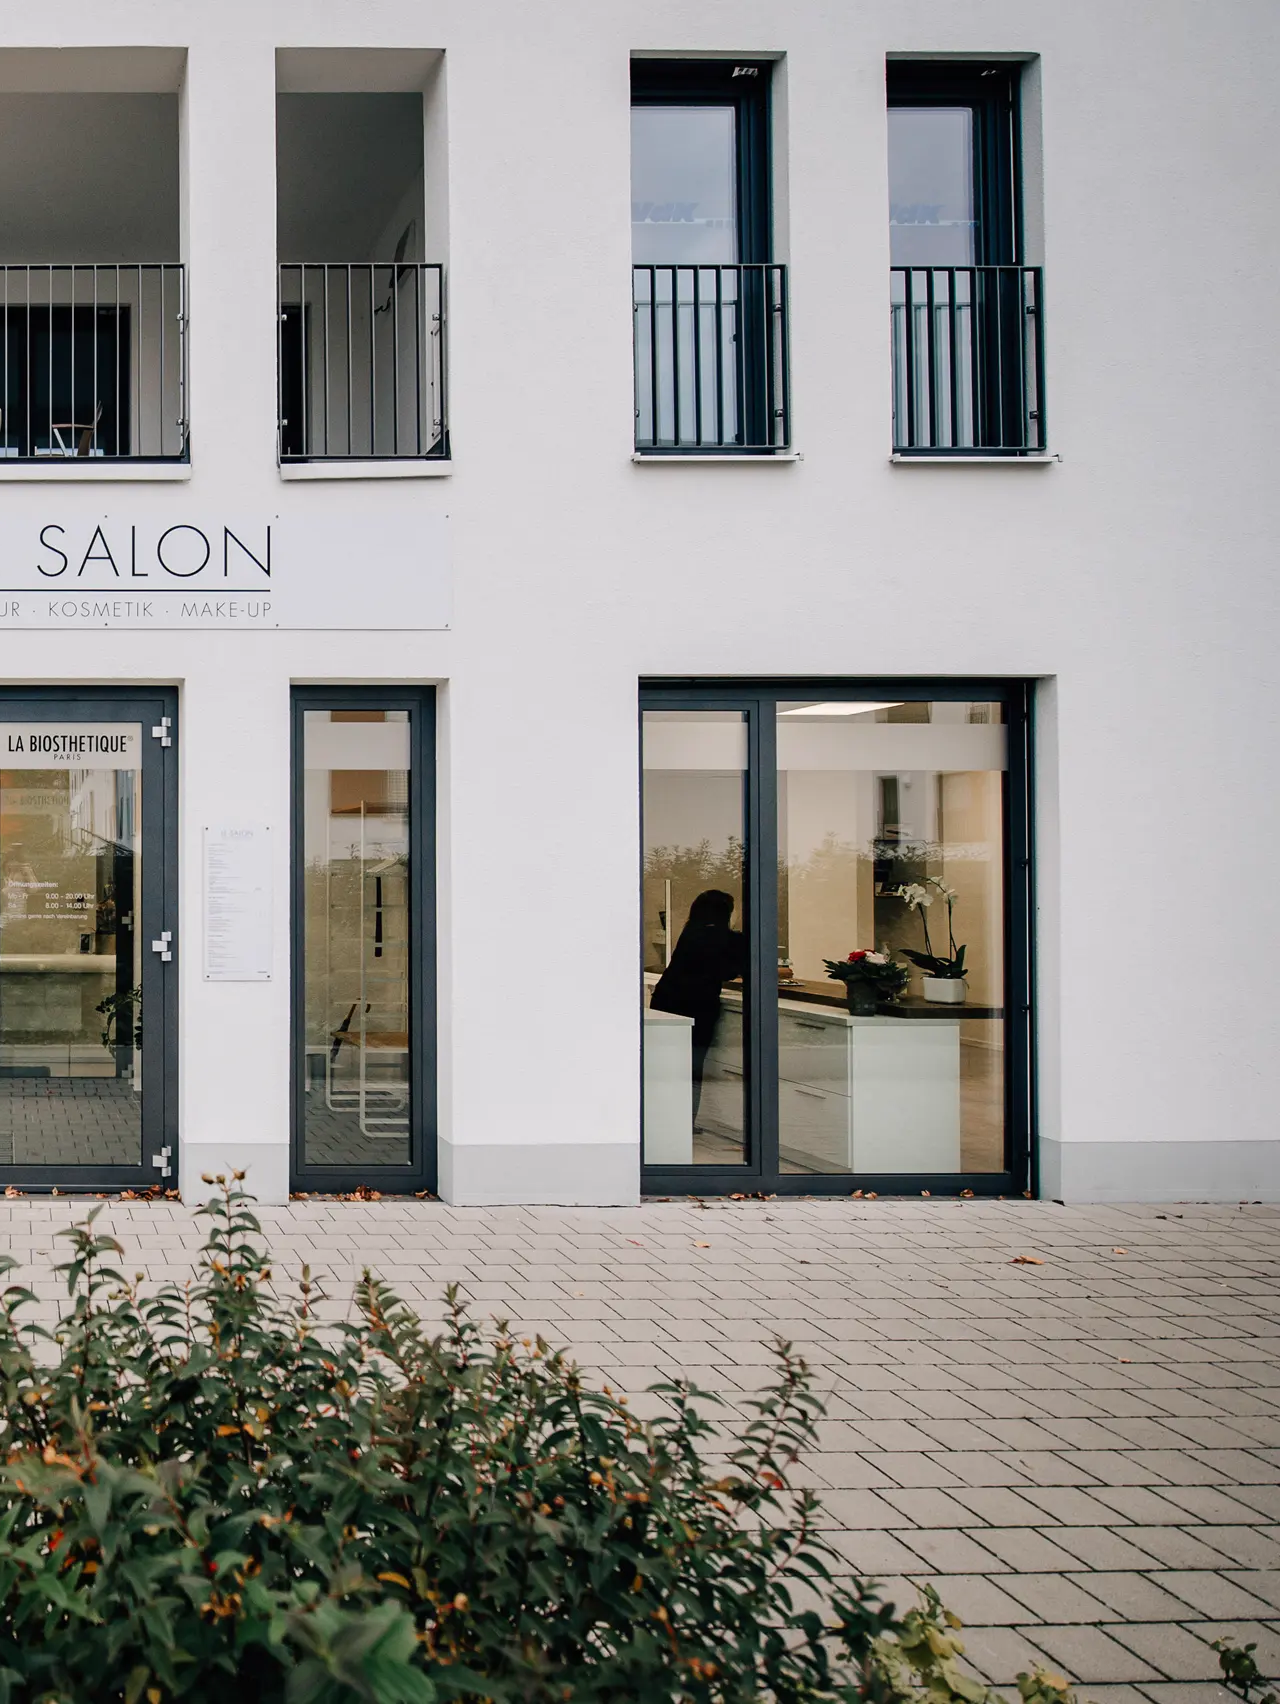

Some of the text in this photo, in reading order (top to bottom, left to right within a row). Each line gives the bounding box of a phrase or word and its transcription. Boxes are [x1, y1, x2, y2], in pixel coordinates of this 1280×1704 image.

[37, 525, 271, 578] SALON
[49, 602, 154, 618] KOSMETIK
[181, 602, 272, 618] MAKE-UP
[8, 735, 24, 752] LA
